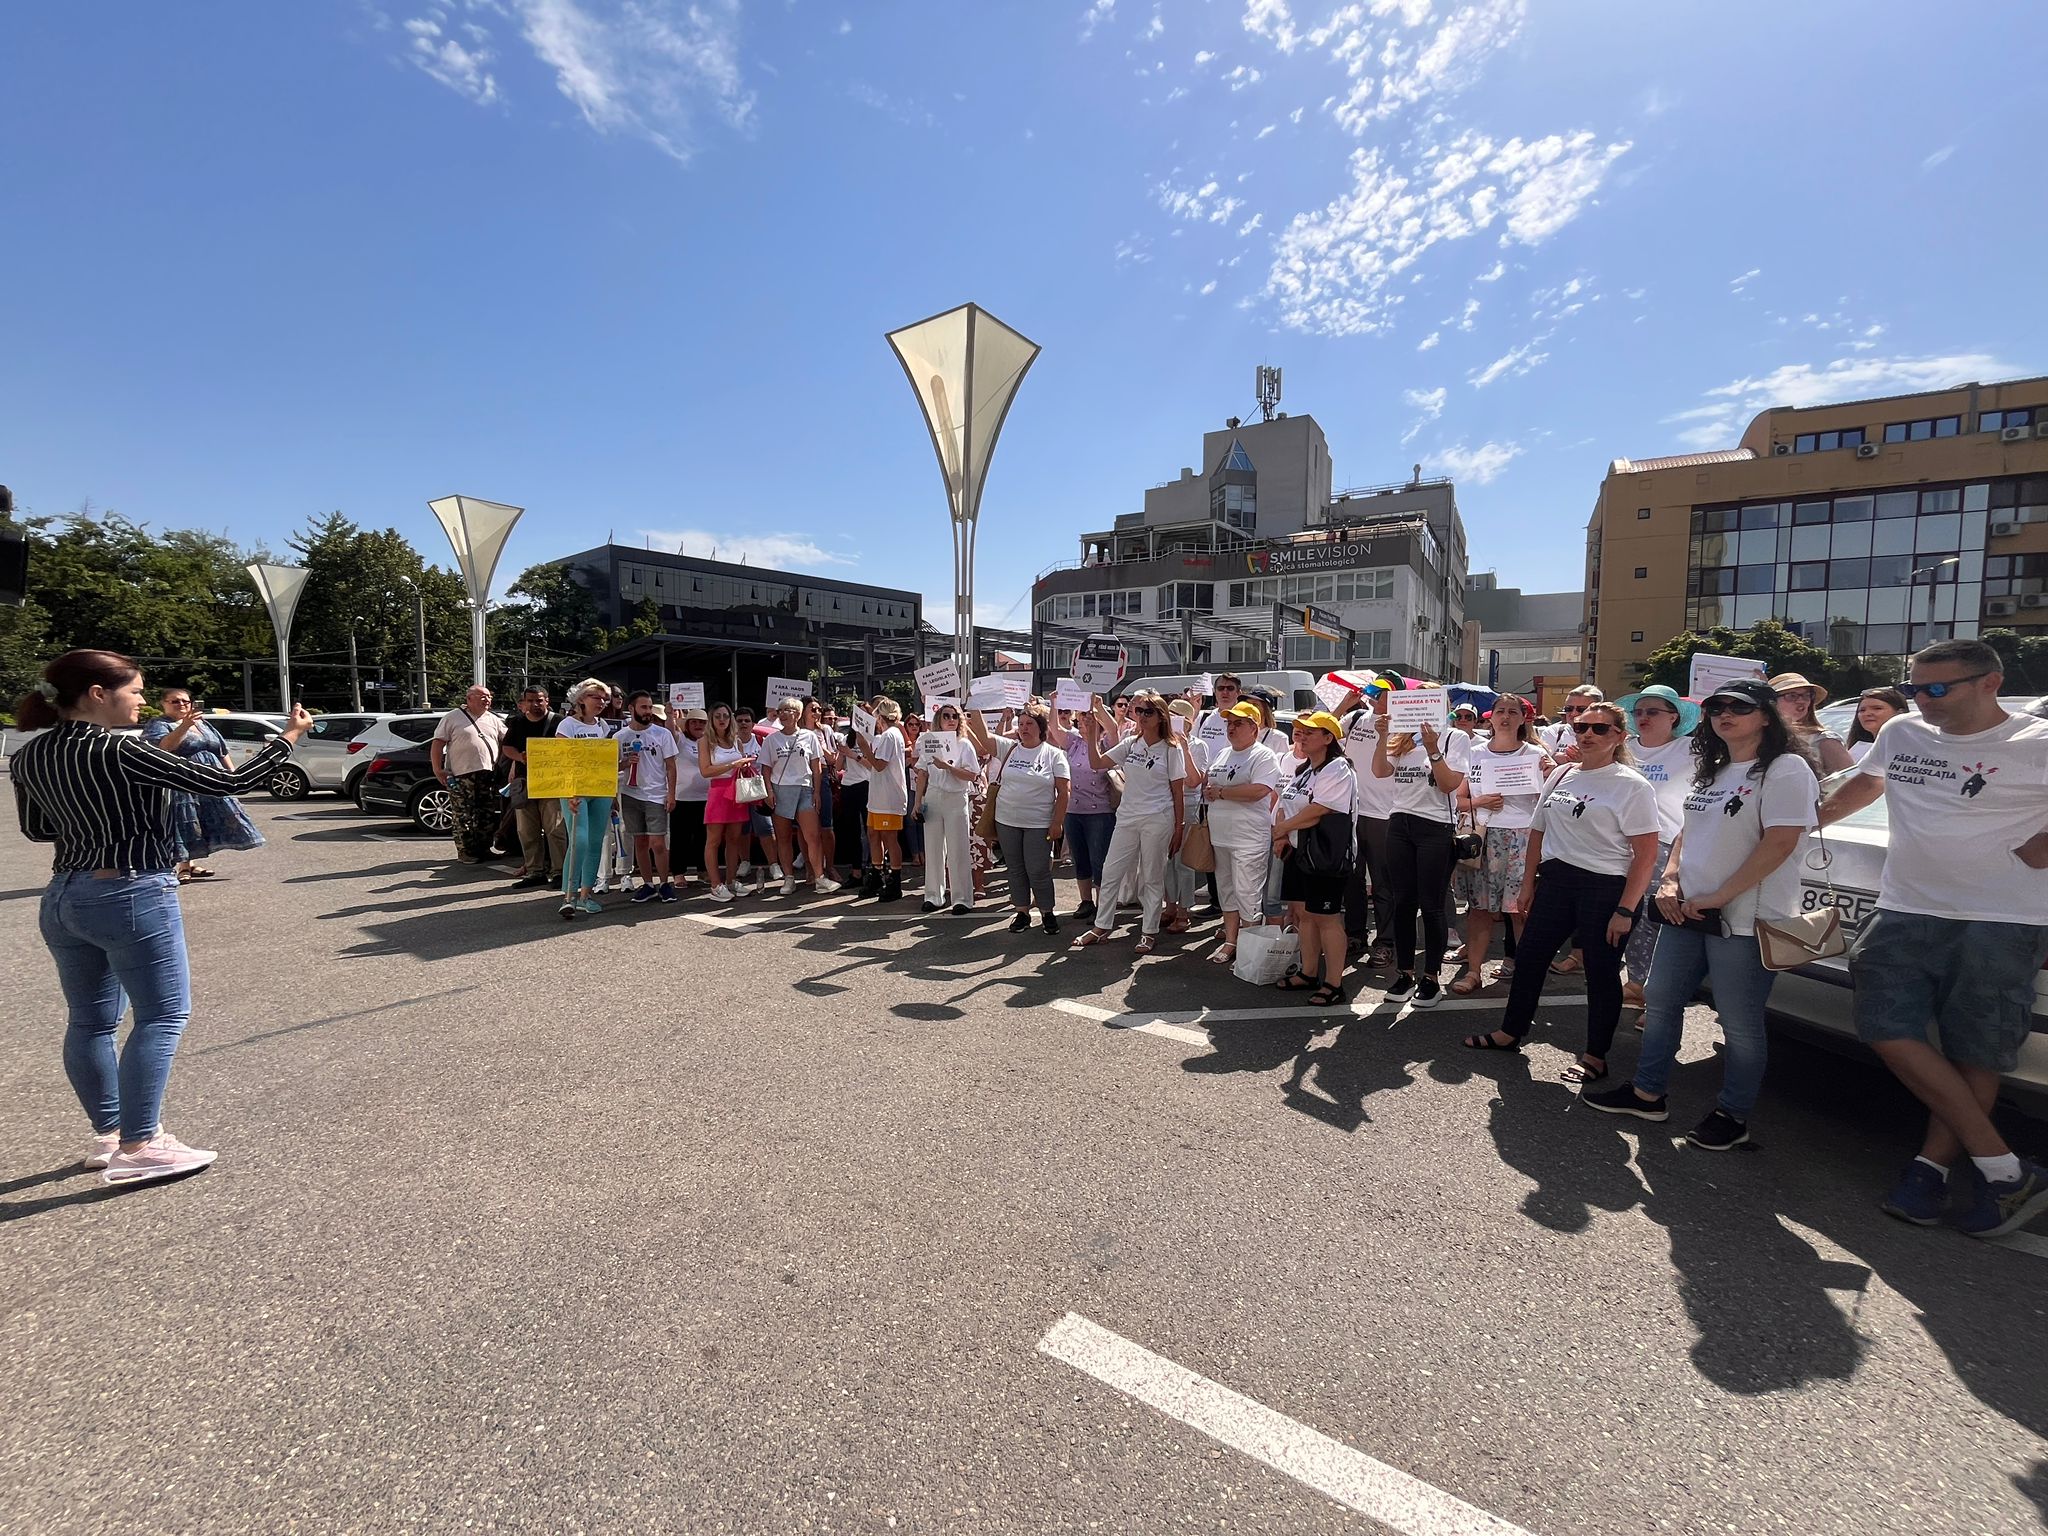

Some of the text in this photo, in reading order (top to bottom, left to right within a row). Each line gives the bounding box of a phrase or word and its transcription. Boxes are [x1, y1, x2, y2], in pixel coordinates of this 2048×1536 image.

[1297, 558, 1356, 571] stomatologică
[922, 666, 949, 679] FĂRĂ HAOS
[1893, 753, 1949, 768] FĂRĂ HAOS
[1400, 771, 1427, 779] LEGISLAȚIA
[1888, 762, 1957, 780] ÎN LEGISLAȚIA
